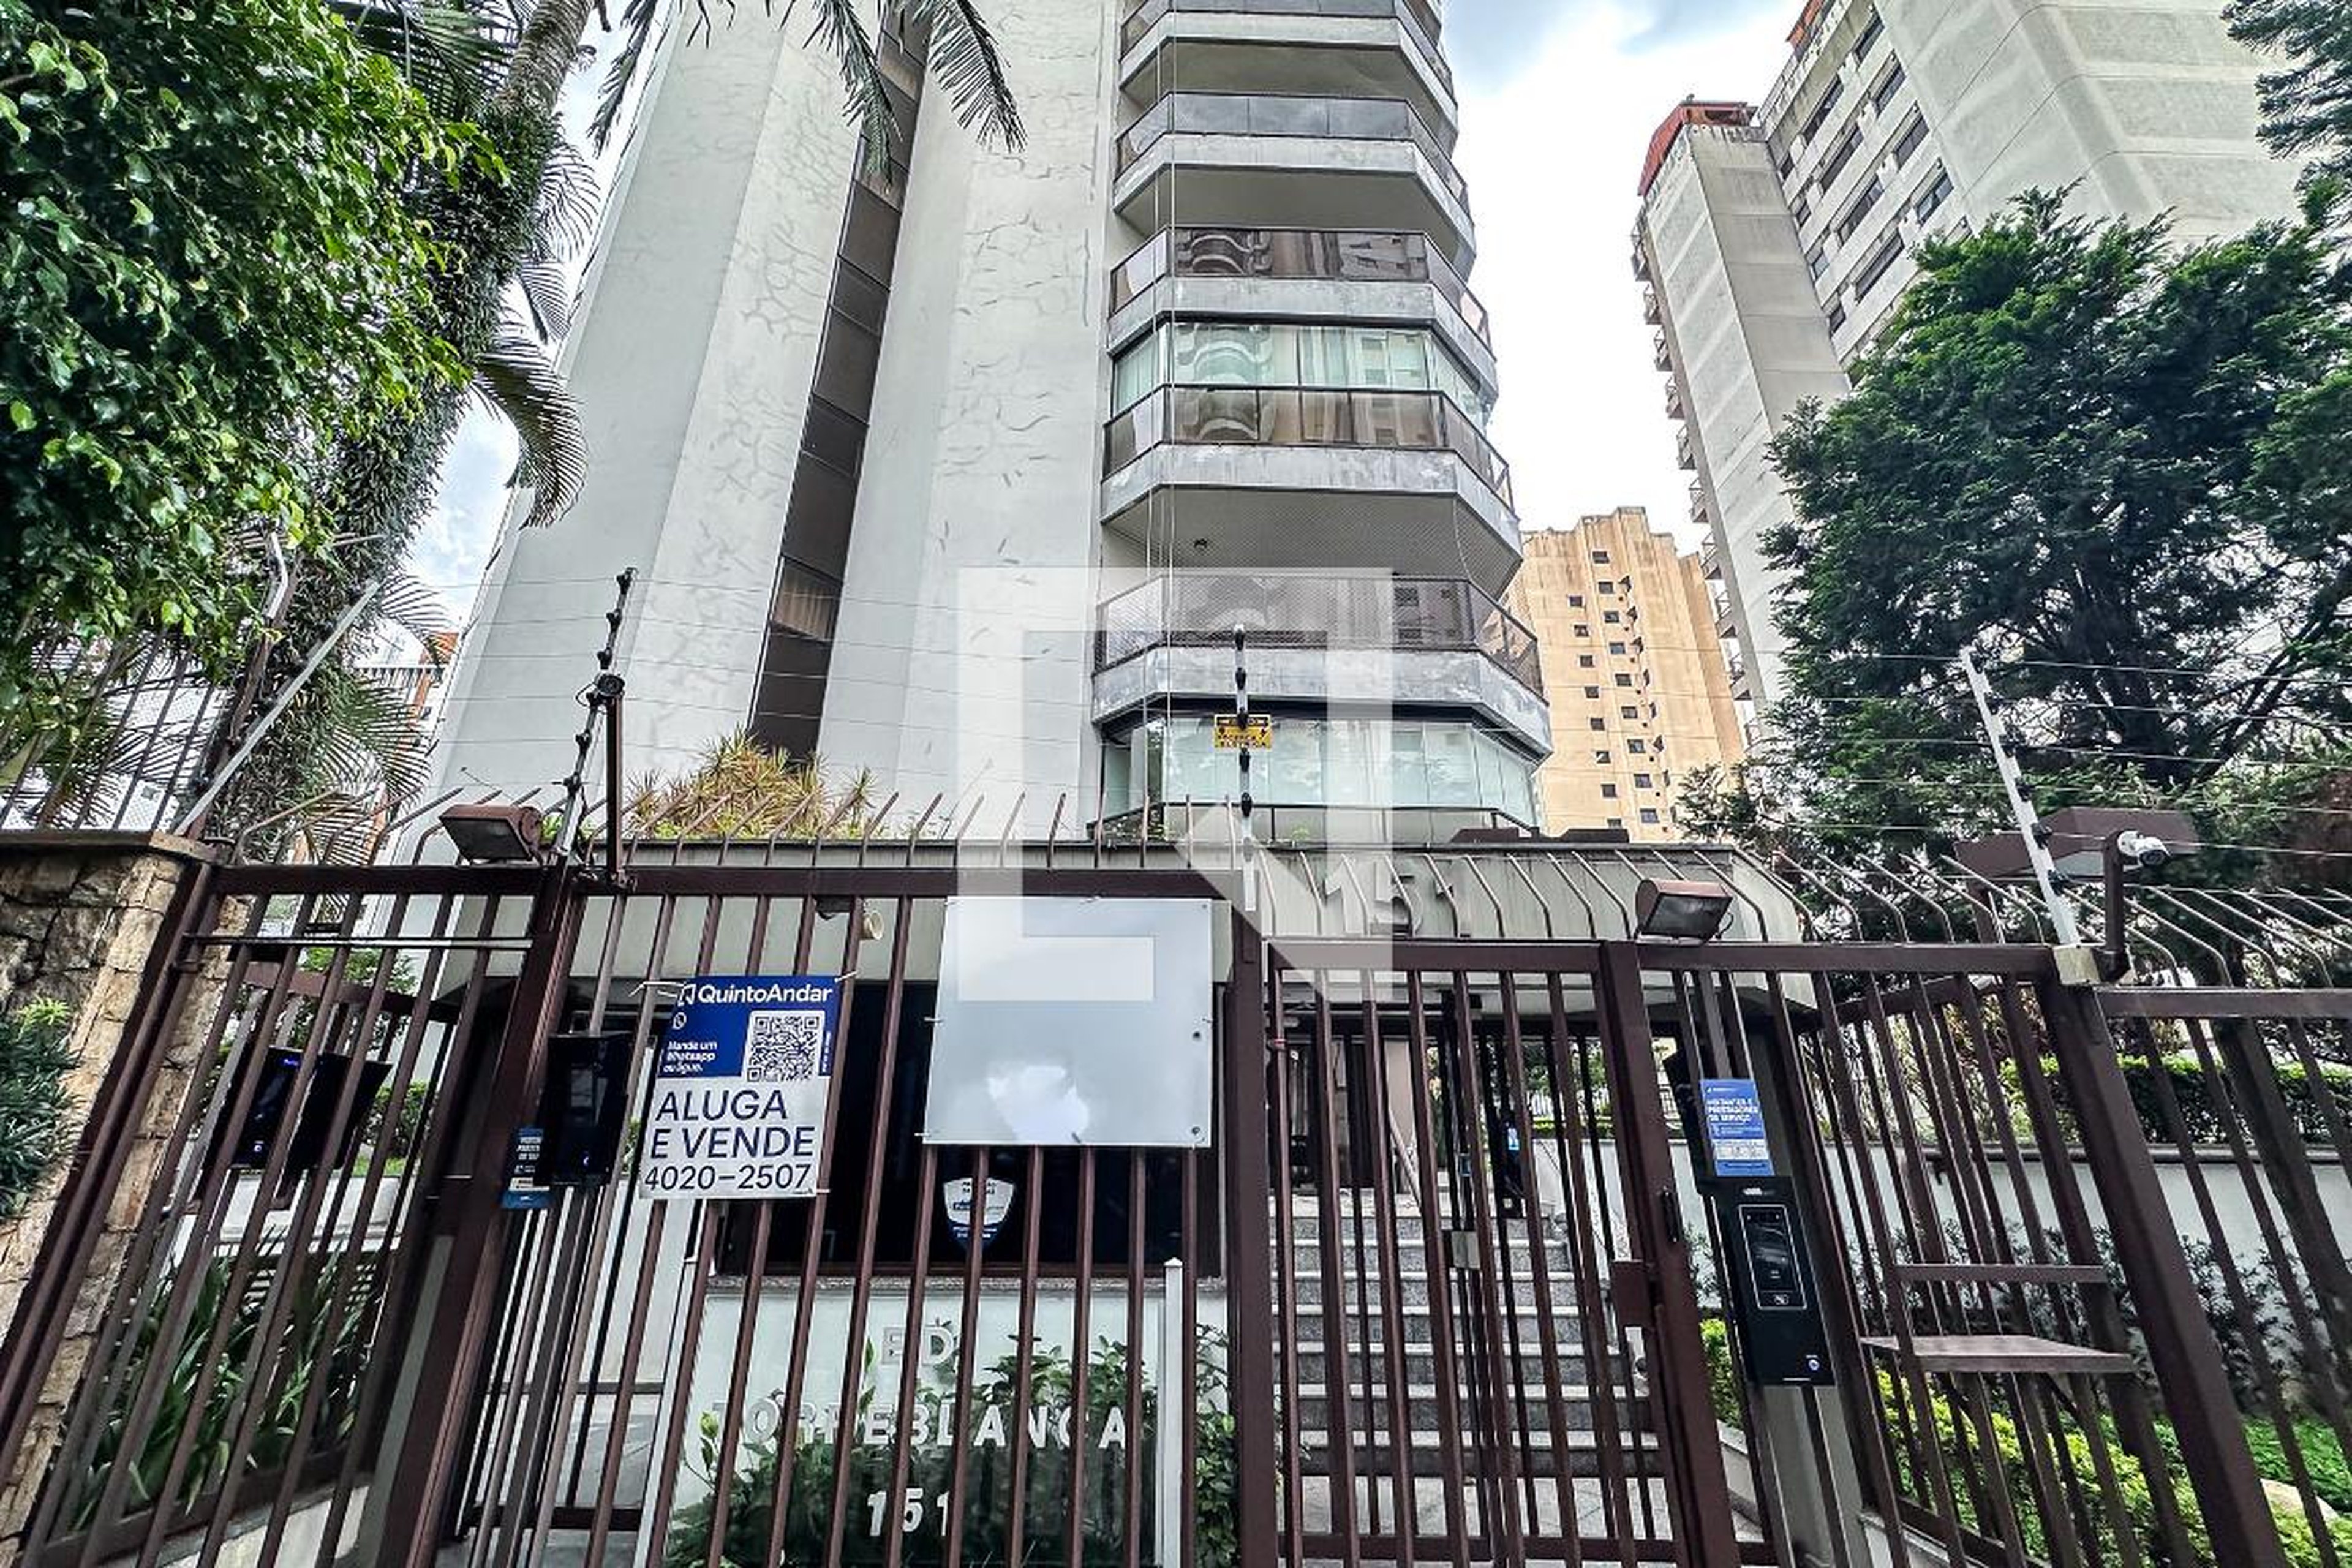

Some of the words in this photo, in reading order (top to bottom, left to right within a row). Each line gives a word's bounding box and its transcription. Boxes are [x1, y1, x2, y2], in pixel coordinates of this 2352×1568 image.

[698, 984, 833, 1005] QuintoAndar
[655, 1090, 788, 1121] ALUGA
[650, 1128, 671, 1159] E
[682, 1126, 815, 1159] VENDE
[644, 1164, 812, 1191] 4020-2507
[867, 1487, 951, 1537] 151
